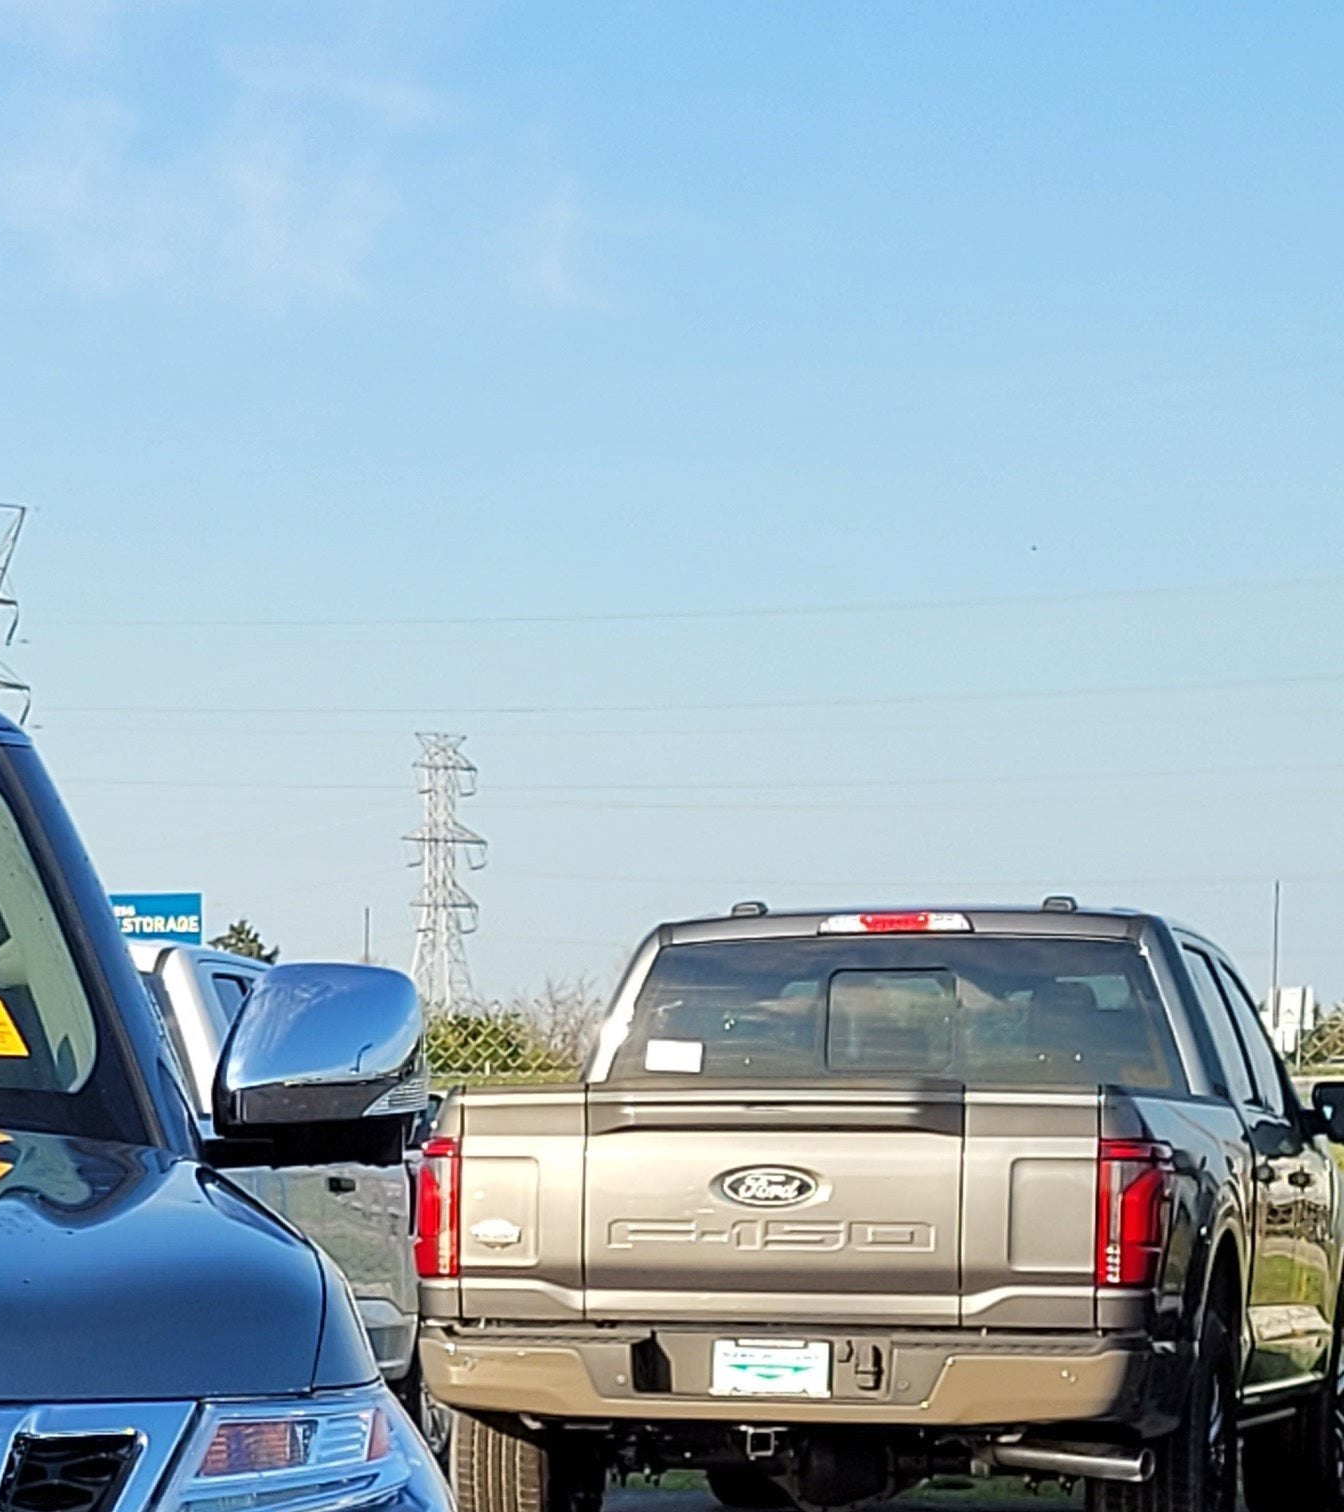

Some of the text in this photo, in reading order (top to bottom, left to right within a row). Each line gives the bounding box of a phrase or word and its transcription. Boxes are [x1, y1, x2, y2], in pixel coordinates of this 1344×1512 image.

[120, 915, 200, 934] STORAGE
[737, 1172, 800, 1200] Ford
[607, 1218, 936, 1252] F-150
